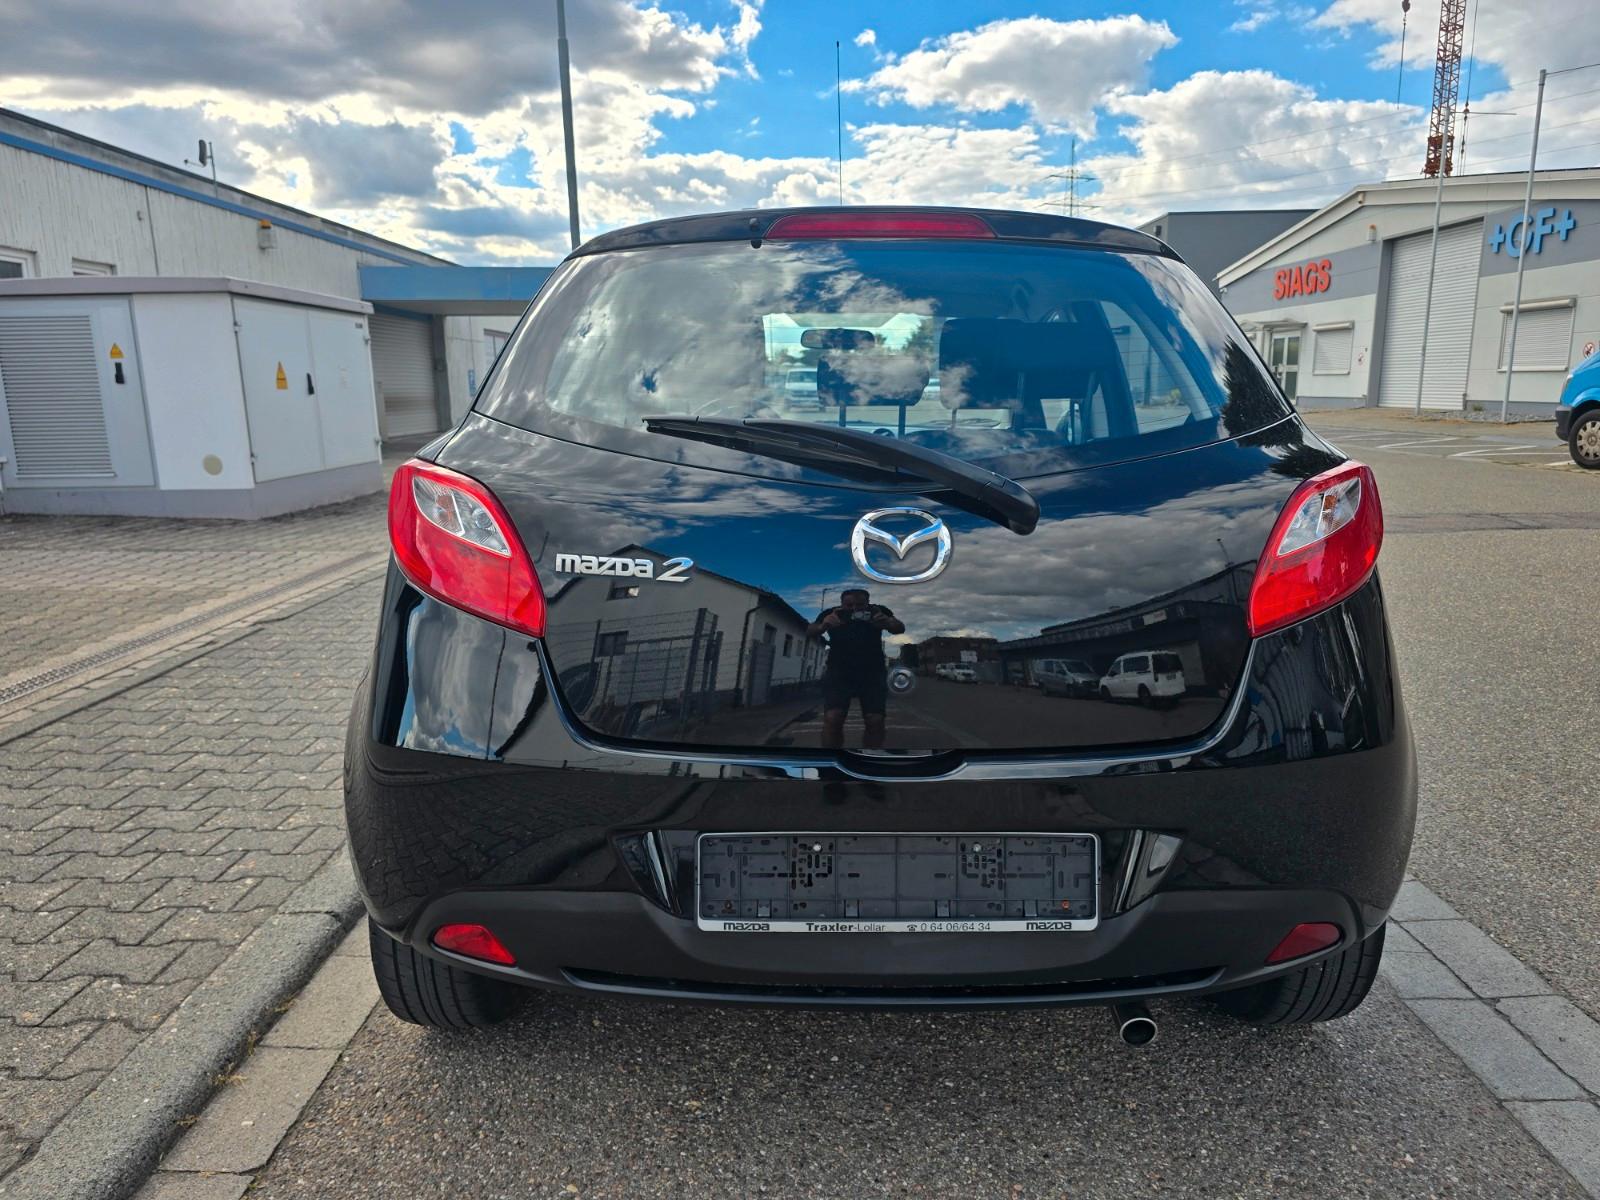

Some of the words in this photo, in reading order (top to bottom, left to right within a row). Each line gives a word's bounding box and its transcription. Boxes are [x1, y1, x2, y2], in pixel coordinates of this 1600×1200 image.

[1273, 259, 1332, 300] SIAGS
[555, 553, 654, 579] mazda
[656, 557, 694, 583] 2
[723, 922, 770, 931] mazda
[930, 922, 943, 931] 64
[945, 922, 975, 931] 06/64
[978, 922, 991, 931] 34
[1026, 921, 1072, 930] mazda
